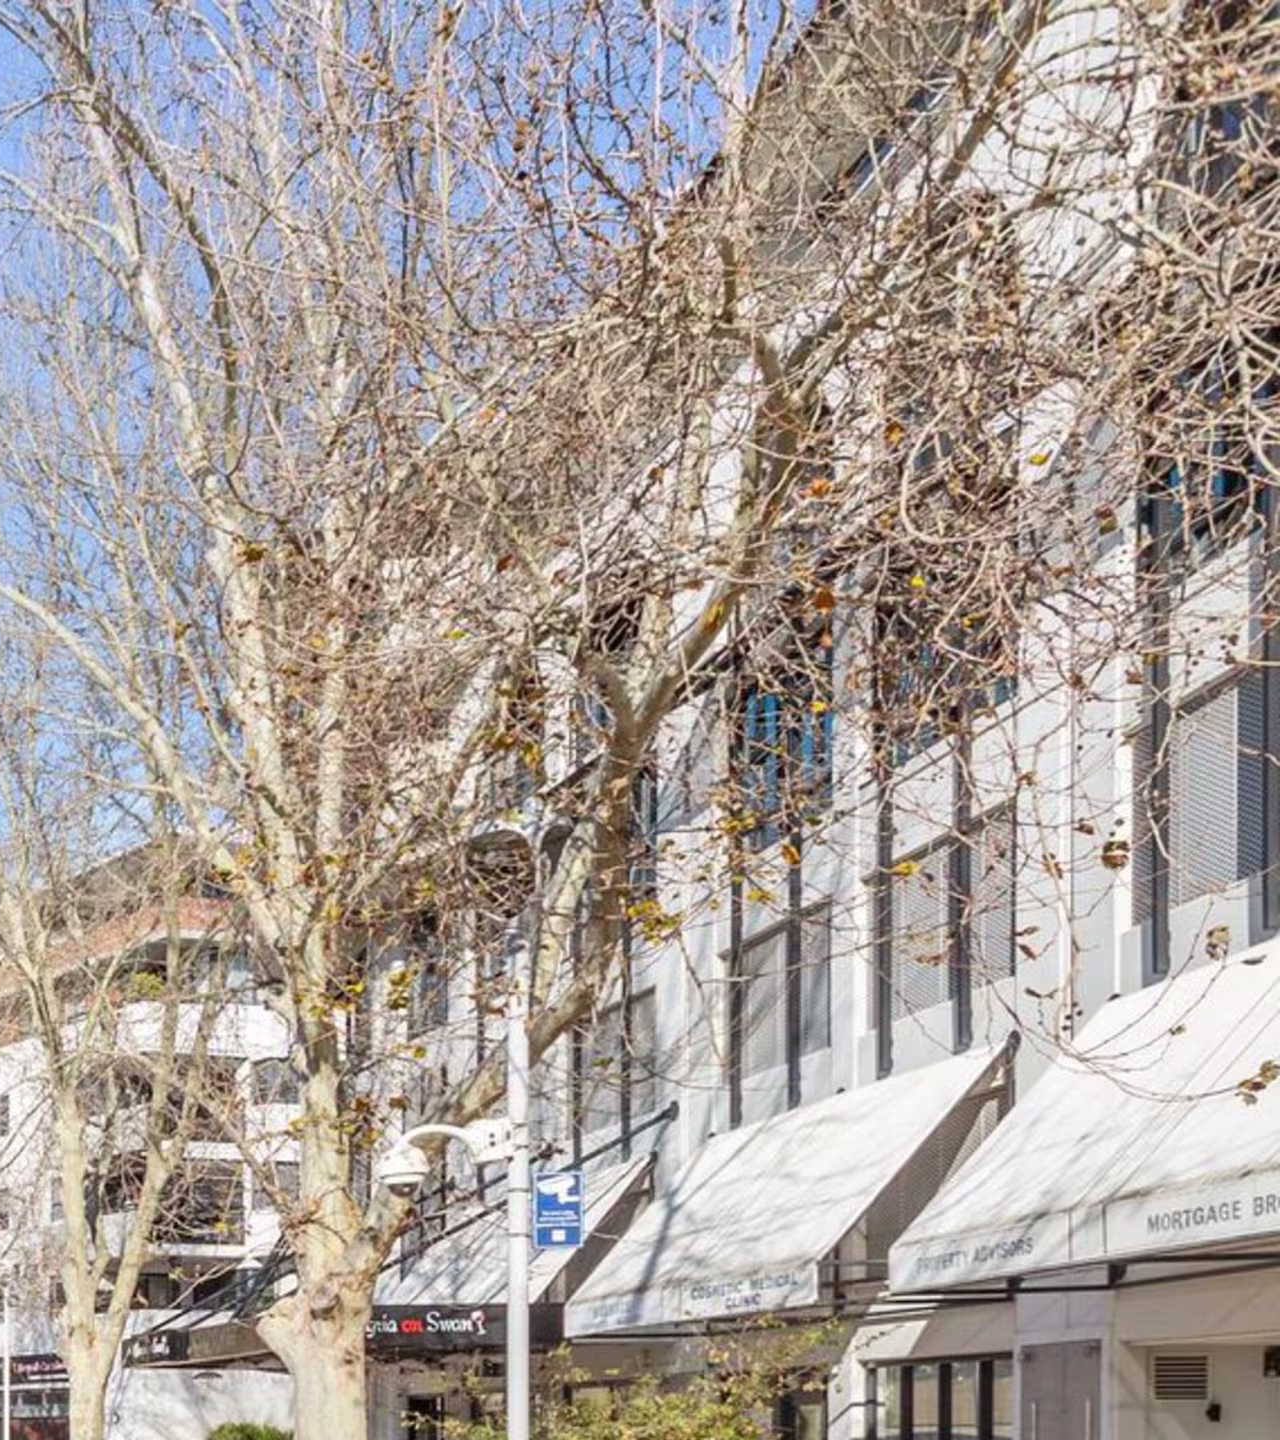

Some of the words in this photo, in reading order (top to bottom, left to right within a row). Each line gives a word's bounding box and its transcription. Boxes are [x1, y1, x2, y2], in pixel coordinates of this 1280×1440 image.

[1146, 1200, 1242, 1234] MORTGAGE
[973, 1236, 1034, 1263] ADVISORS
[690, 1280, 744, 1301] COSMETIC
[749, 1272, 799, 1292] MEDICAL
[724, 1293, 762, 1311] CLINIC
[365, 1313, 399, 1339] gria
[401, 1318, 423, 1333] on
[426, 1311, 473, 1334] Swan
